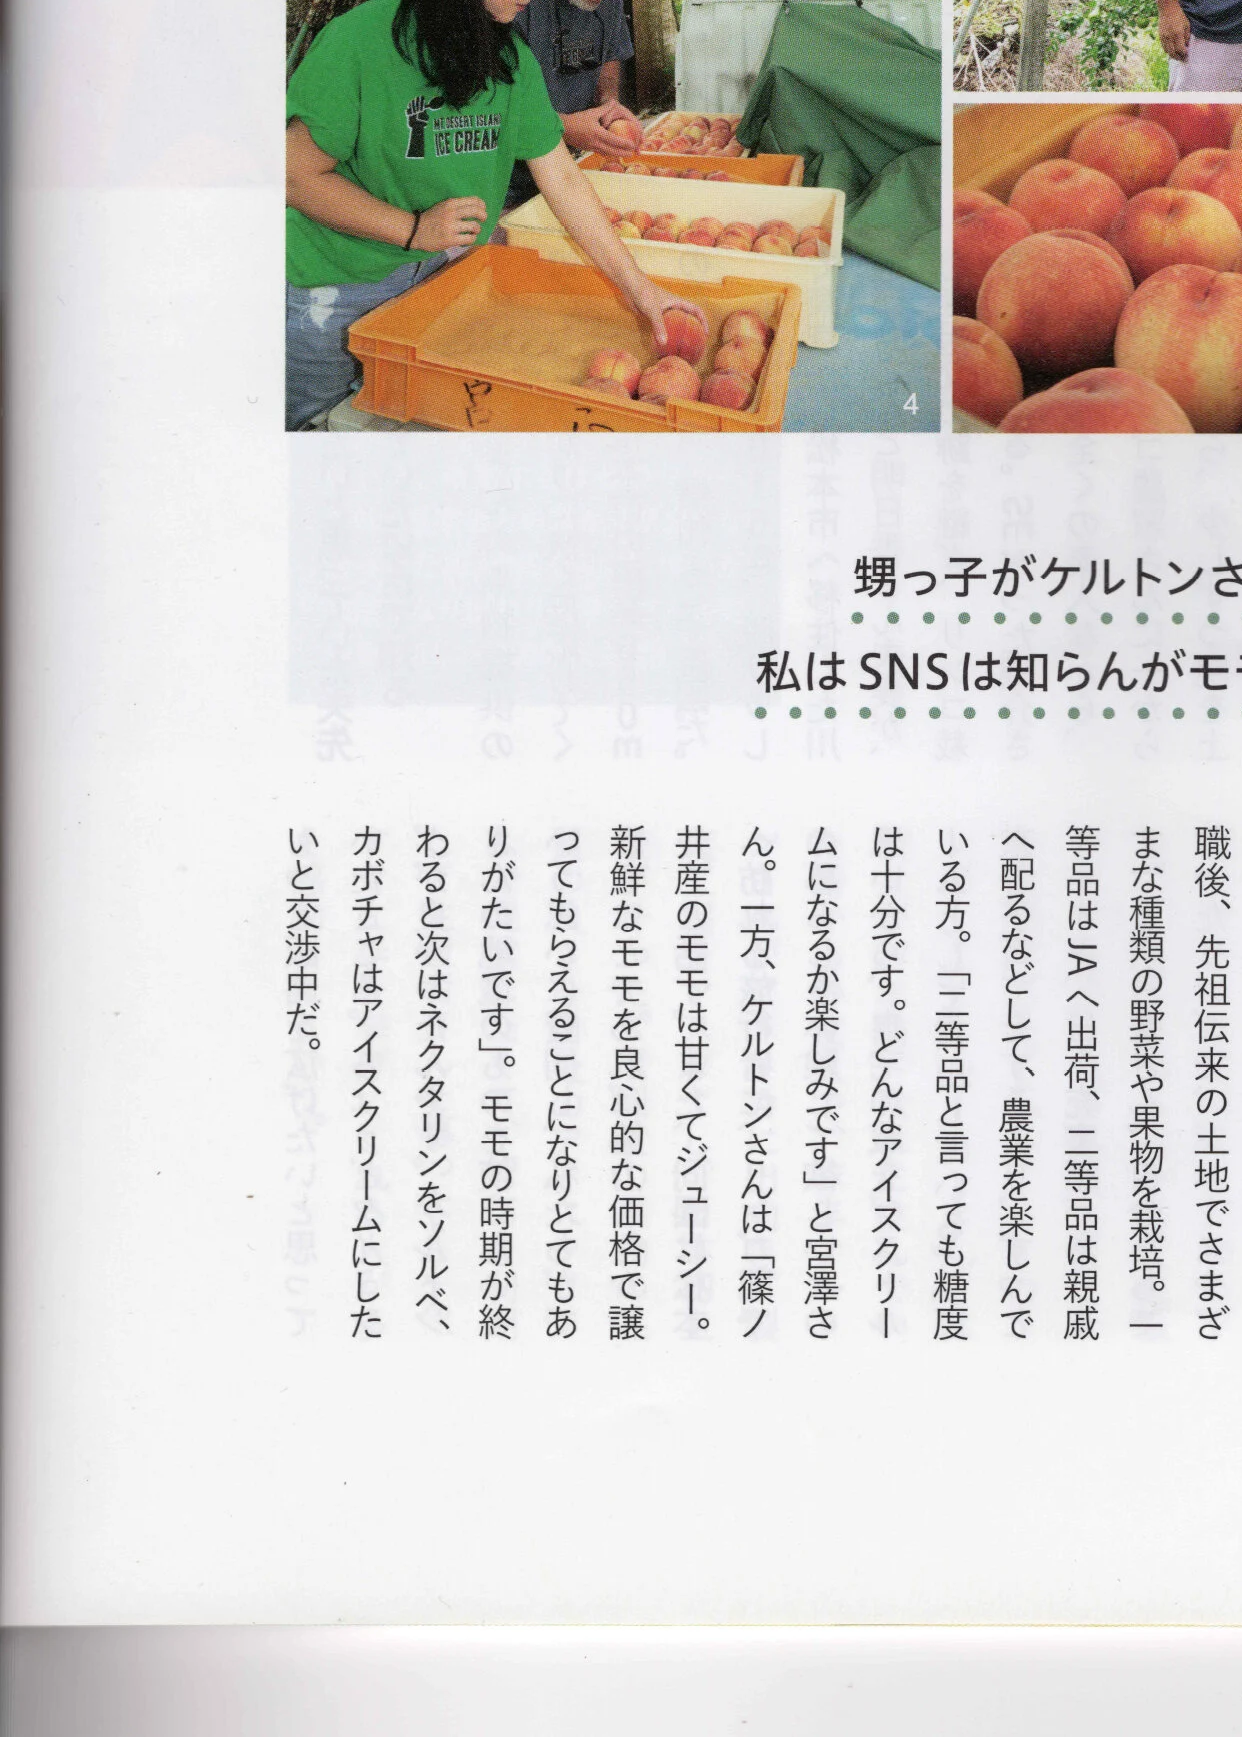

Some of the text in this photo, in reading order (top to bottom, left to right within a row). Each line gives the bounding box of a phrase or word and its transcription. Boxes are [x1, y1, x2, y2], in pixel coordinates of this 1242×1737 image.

[434, 132, 451, 157] ICE
[903, 392, 919, 415] 4
[285, 828, 321, 1050] いと交渉中だ。
[350, 825, 385, 1338] カボチャはアイスクリームにした
[414, 824, 450, 1330] わると次はネクタリンをソルベ、
[478, 825, 516, 1340] りがたいです」。モモの時期が終
[546, 831, 579, 1339] ってもらえることになりとてもあ
[608, 824, 646, 1341] 新鮮なモモを良心的な価格で譲
[674, 824, 710, 1330] 井産のモモは甘くてジューシー。
[738, 826, 776, 1338] ん。一方、ケルトンさんは「篠ノ
[802, 826, 840, 1339] ムになるか楽しみです」と宮澤さ
[870, 826, 906, 1339] は十分です。どんなアイスクリー
[933, 829, 971, 1341] いる方。「二等品と言っても糖度
[998, 832, 1035, 1339] へ配るなどして、農業を楽しんで
[1063, 824, 1100, 1341] 等品はJAへ出荷、二等品は親戚
[1128, 825, 1166, 1328] まな種類の野菜や果物を栽培。一
[1193, 824, 1232, 1340] 職後、先祖伝来の土地でさまざ
